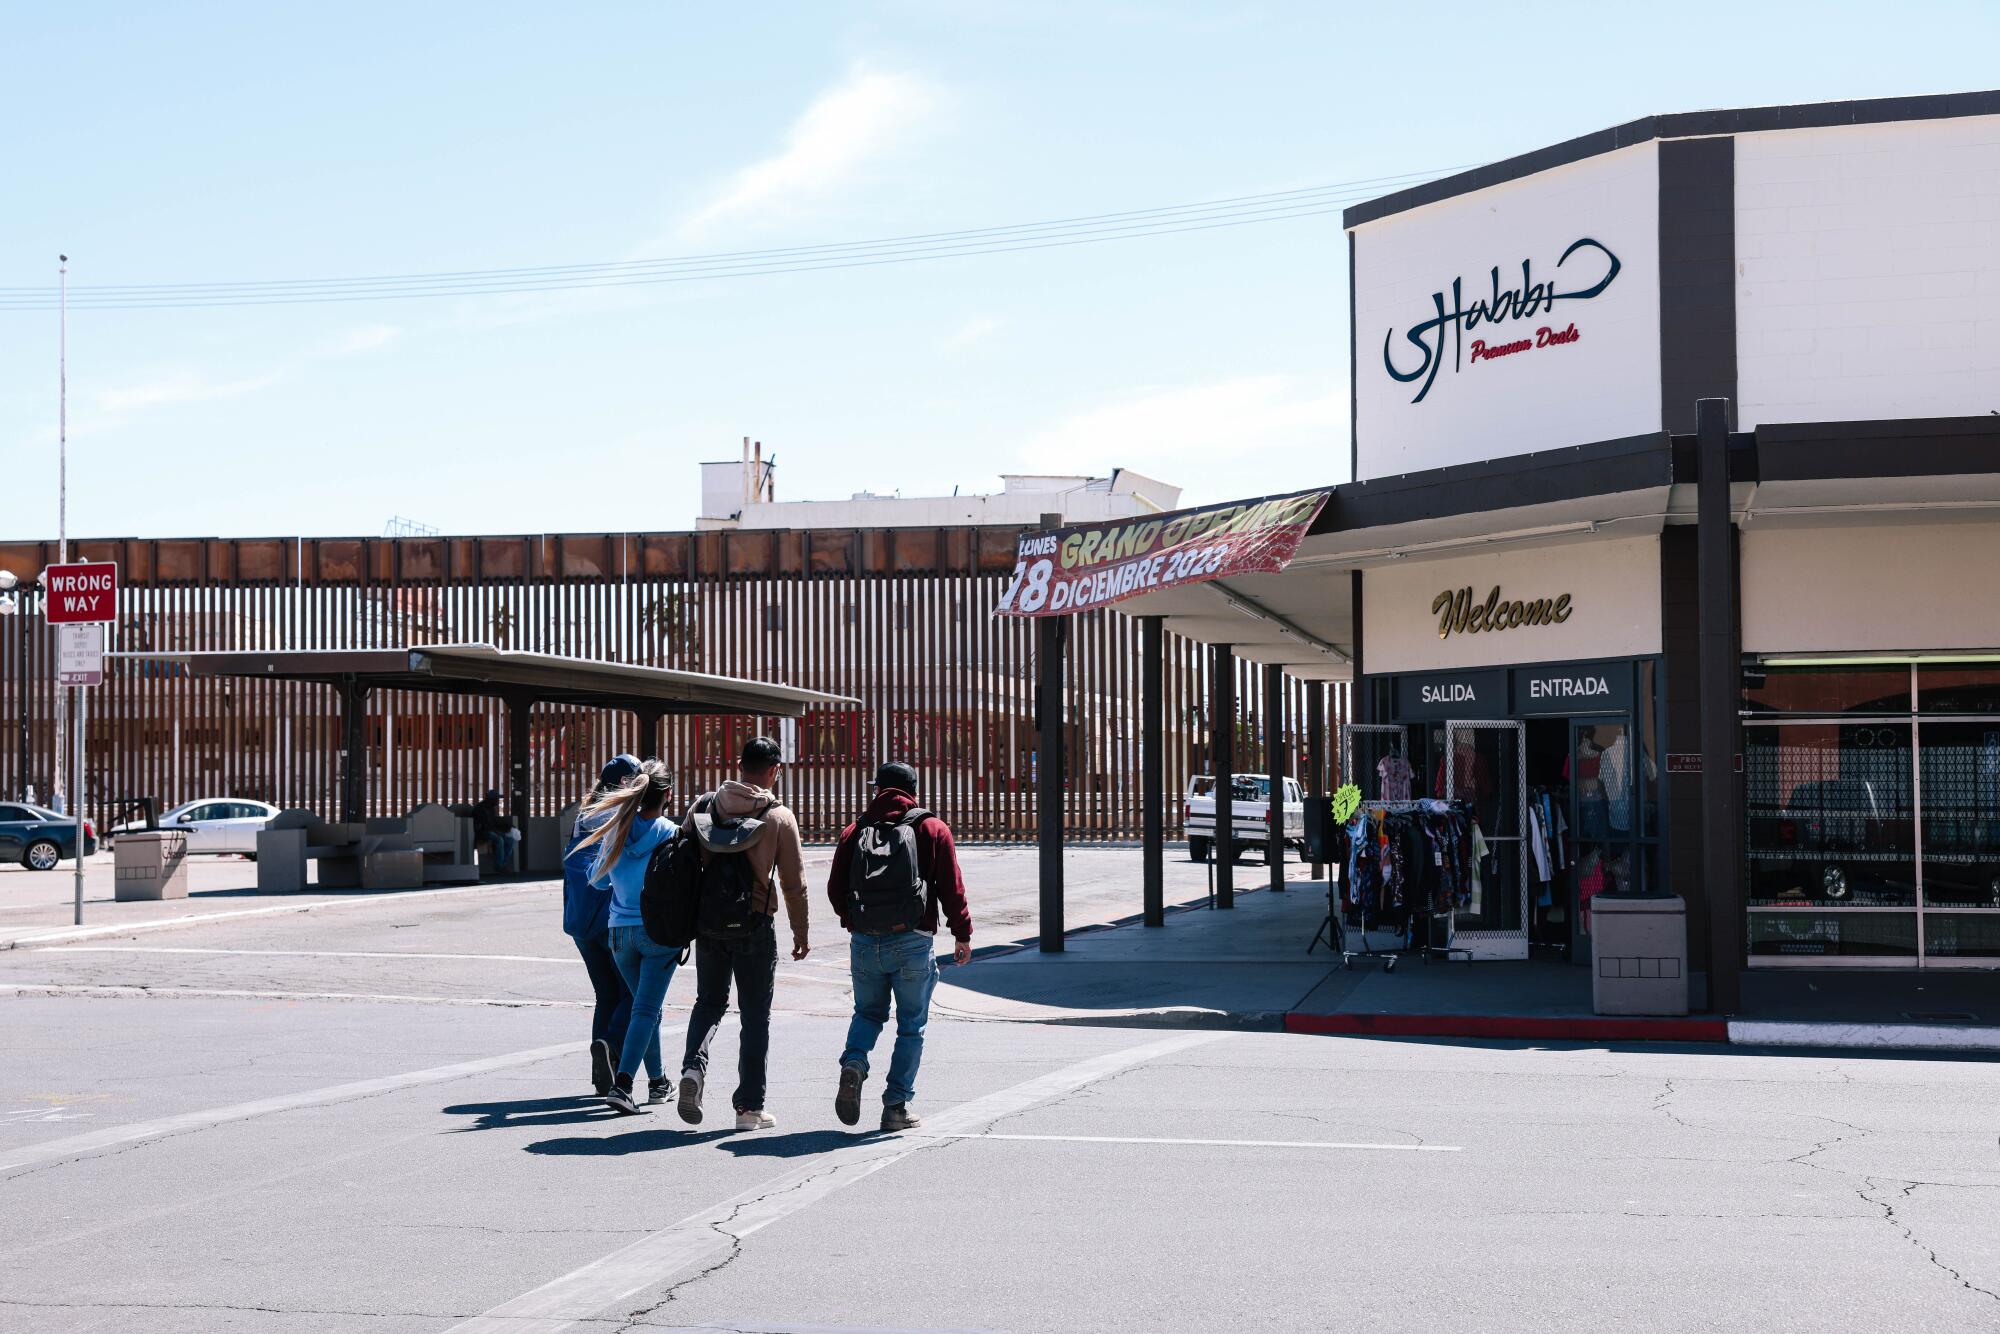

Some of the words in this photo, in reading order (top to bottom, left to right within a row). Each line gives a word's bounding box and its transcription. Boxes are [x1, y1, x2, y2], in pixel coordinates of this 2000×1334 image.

[1471, 339, 1532, 364] Premium
[1536, 323, 1580, 348] Deals
[1019, 536, 1057, 556] LUNES
[1060, 520, 1164, 569] GRAND
[52, 574, 111, 592] WRONG
[998, 559, 1053, 612] 18
[1050, 556, 1158, 611] DICIEMBRE
[1163, 543, 1229, 580] 2023
[63, 595, 100, 612] WAY
[1432, 585, 1573, 640] Welcome
[1421, 684, 1476, 703] SALIDA
[1530, 676, 1610, 698] ENTRADA
